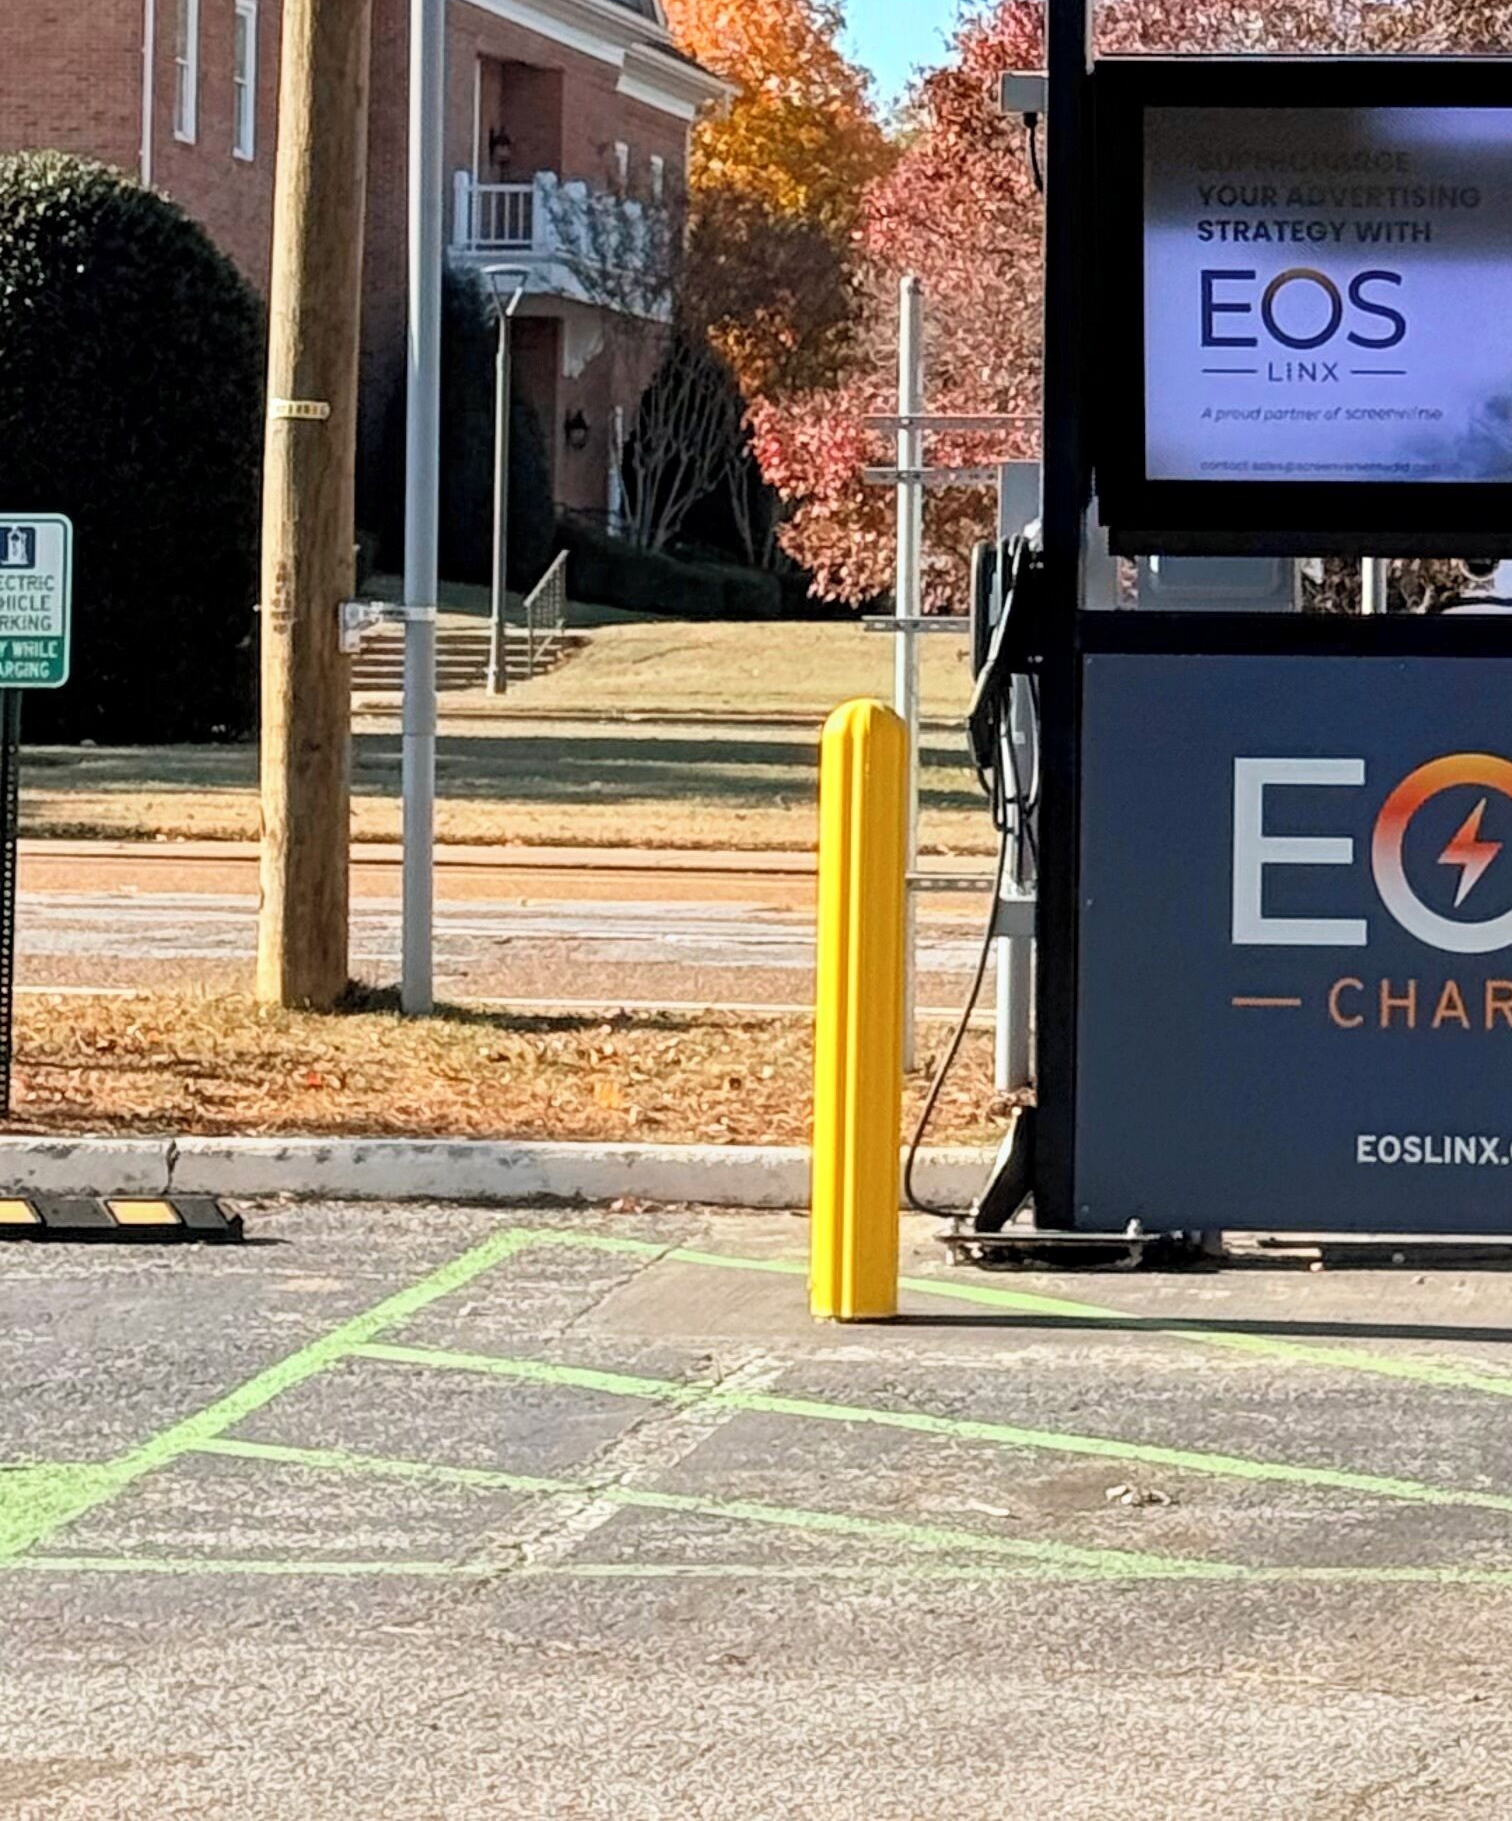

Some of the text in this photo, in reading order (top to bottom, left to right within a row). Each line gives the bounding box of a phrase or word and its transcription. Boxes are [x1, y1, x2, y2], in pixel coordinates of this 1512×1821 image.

[1197, 184, 1481, 209] YOUR ADVERTISING
[1196, 219, 1432, 243] STRATEGY WITH
[1201, 267, 1406, 350] EOS
[1268, 361, 1339, 382] LINX
[1201, 407, 1212, 419] A
[1214, 407, 1261, 422] proud
[1263, 408, 1321, 421] partner
[1323, 406, 1342, 420] of
